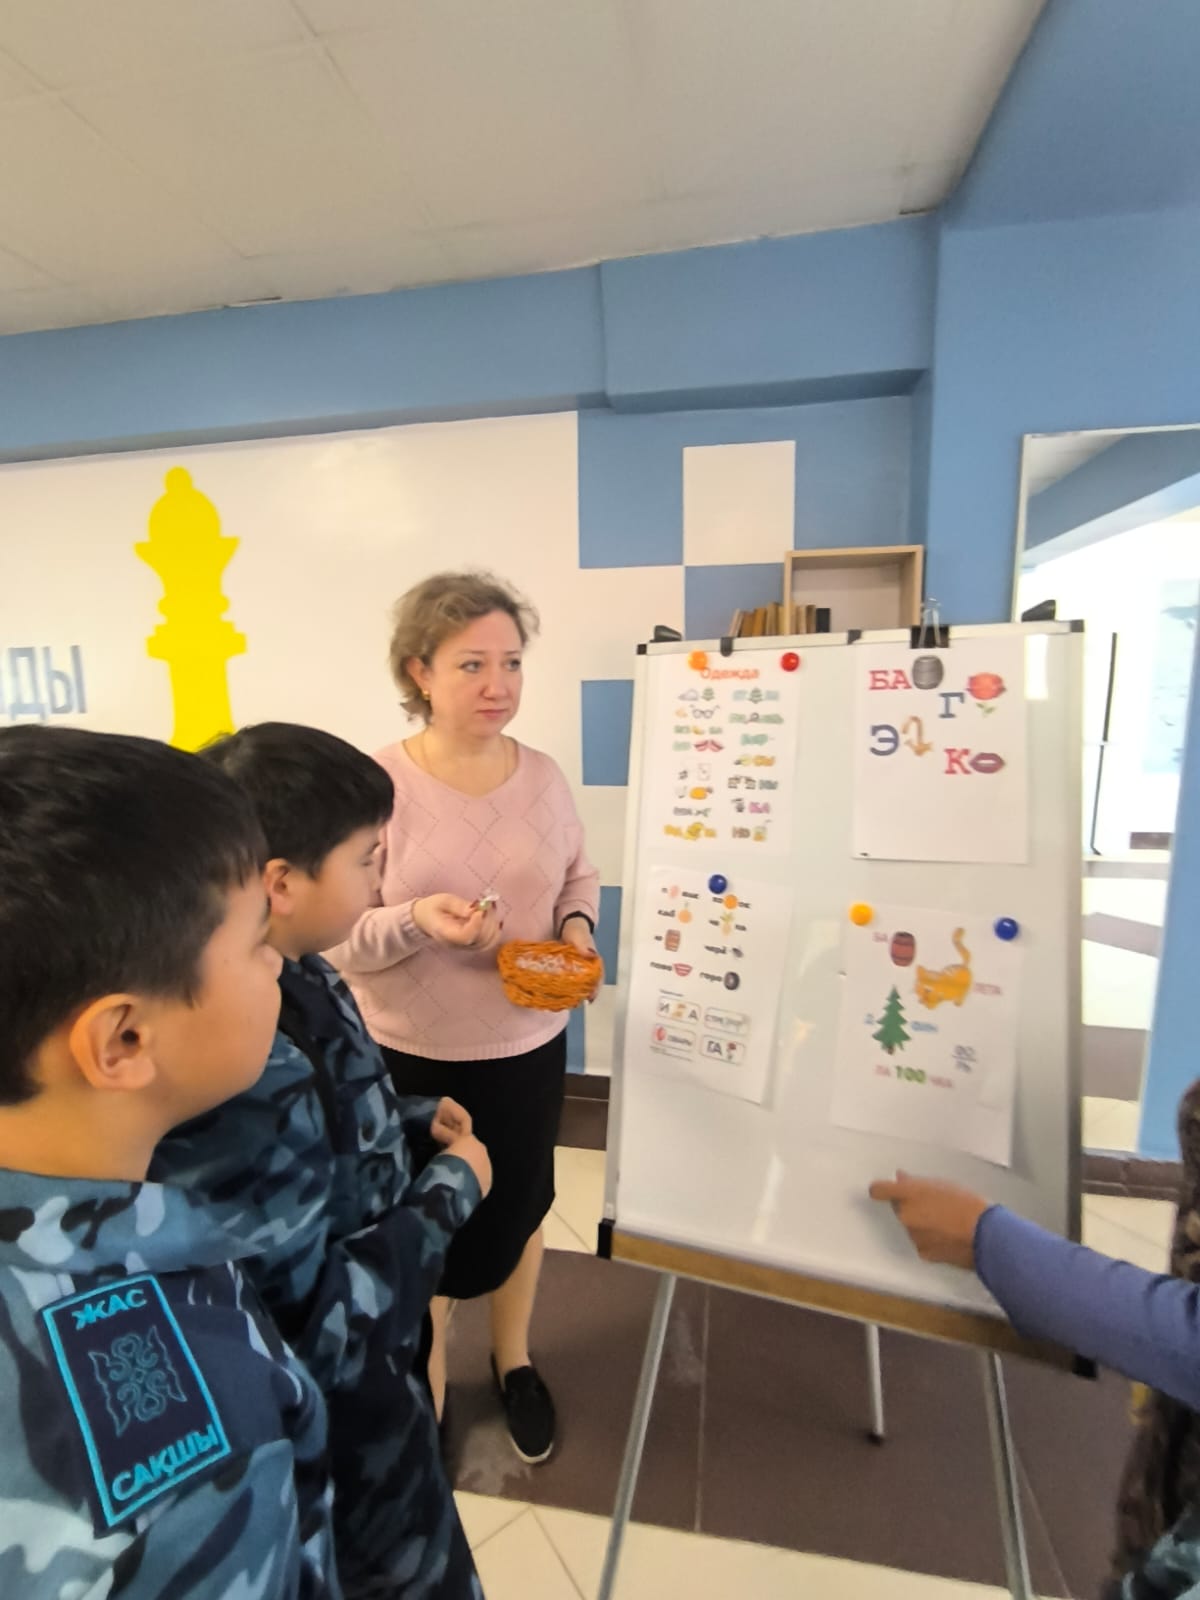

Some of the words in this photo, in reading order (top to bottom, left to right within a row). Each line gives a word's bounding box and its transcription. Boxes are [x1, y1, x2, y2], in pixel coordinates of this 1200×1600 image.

[0, 645, 87, 721] ДЫ
[700, 667, 760, 680] Одежда
[869, 669, 912, 690] БА
[938, 692, 965, 718] Г
[870, 724, 900, 756] Э
[944, 748, 972, 775] К
[896, 1065, 927, 1084] 100
[72, 1289, 148, 1330] ЖАС
